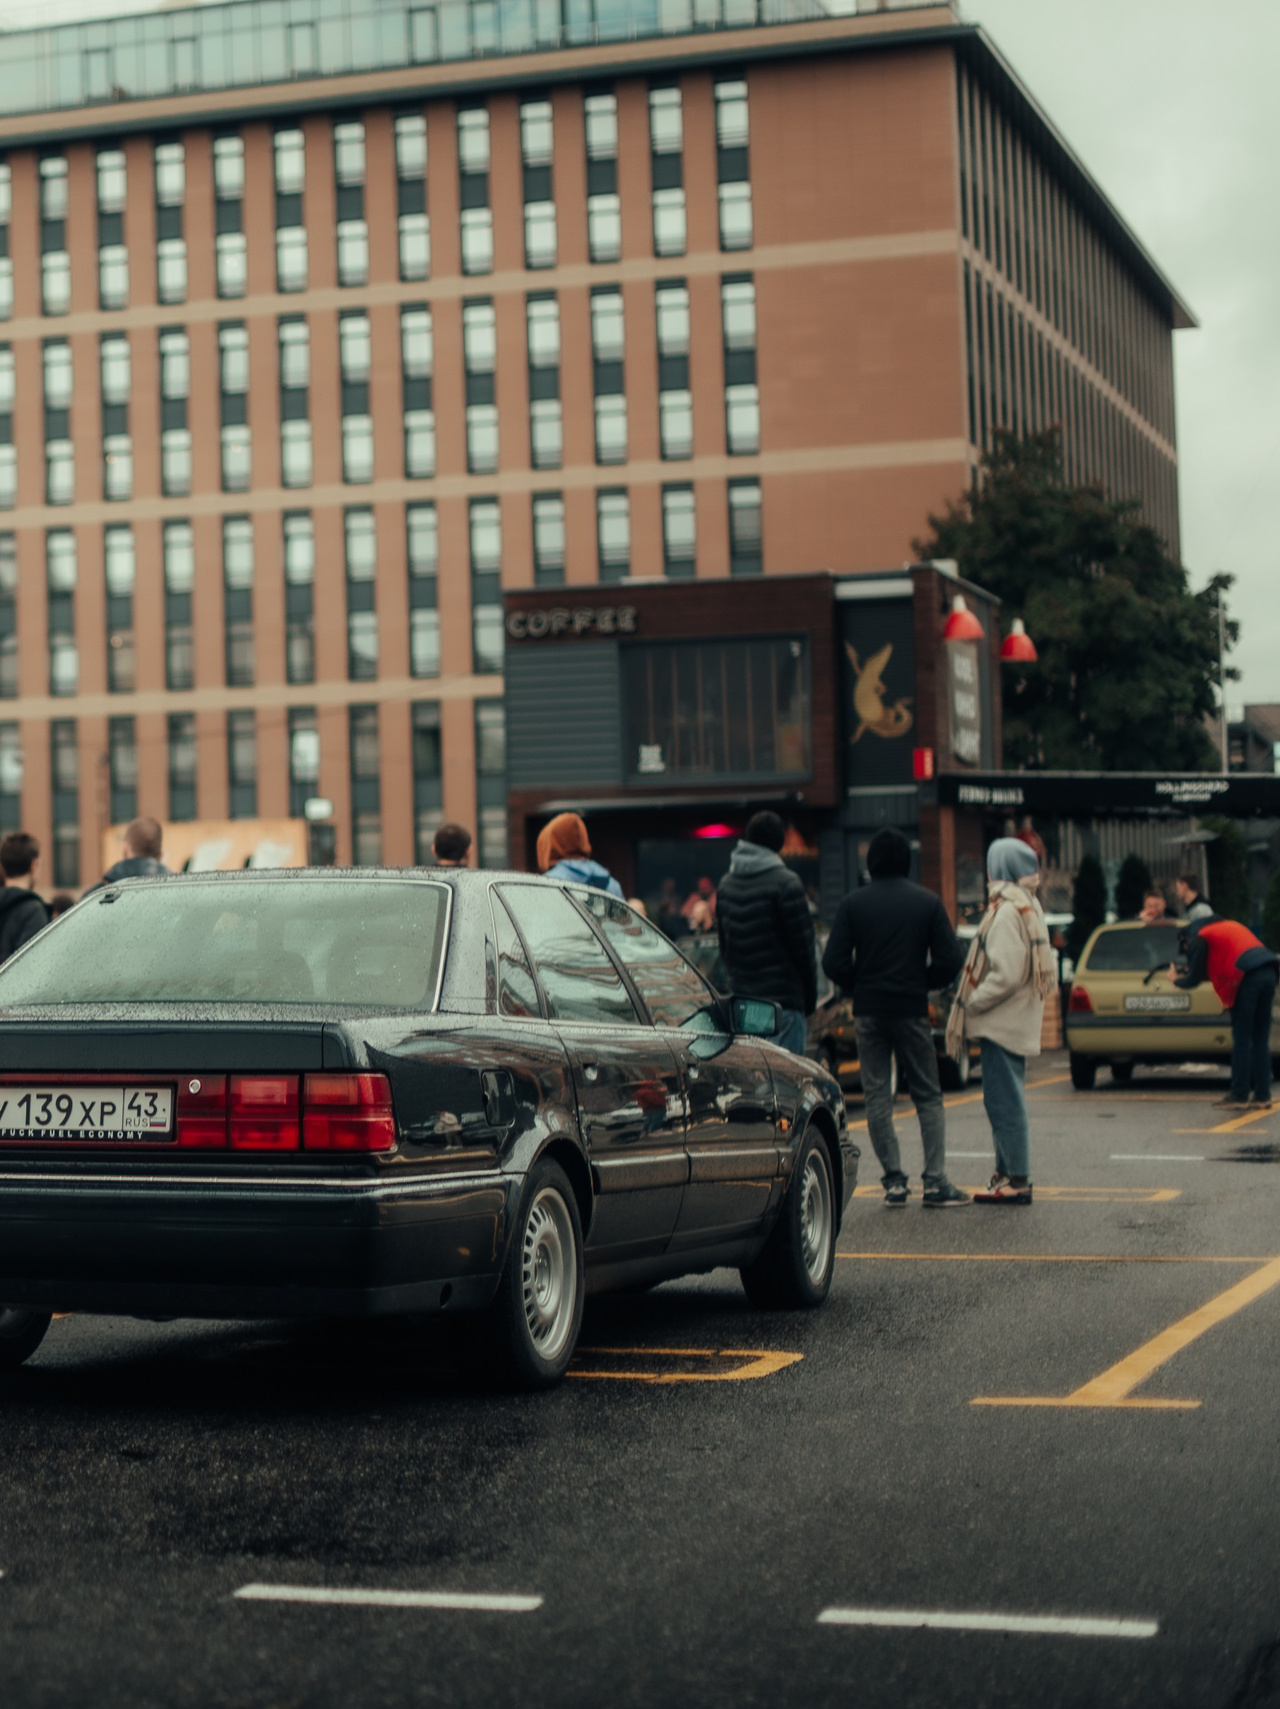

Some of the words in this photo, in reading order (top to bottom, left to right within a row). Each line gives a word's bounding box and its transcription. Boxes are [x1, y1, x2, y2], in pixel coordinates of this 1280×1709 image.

[506, 606, 638, 638] COFFEE
[127, 1092, 159, 1117] 43
[125, 1117, 149, 1128] RUS
[1, 1128, 35, 1138] FUCK
[41, 1129, 73, 1138] FUEL
[79, 1130, 143, 1140] ECONOMY
